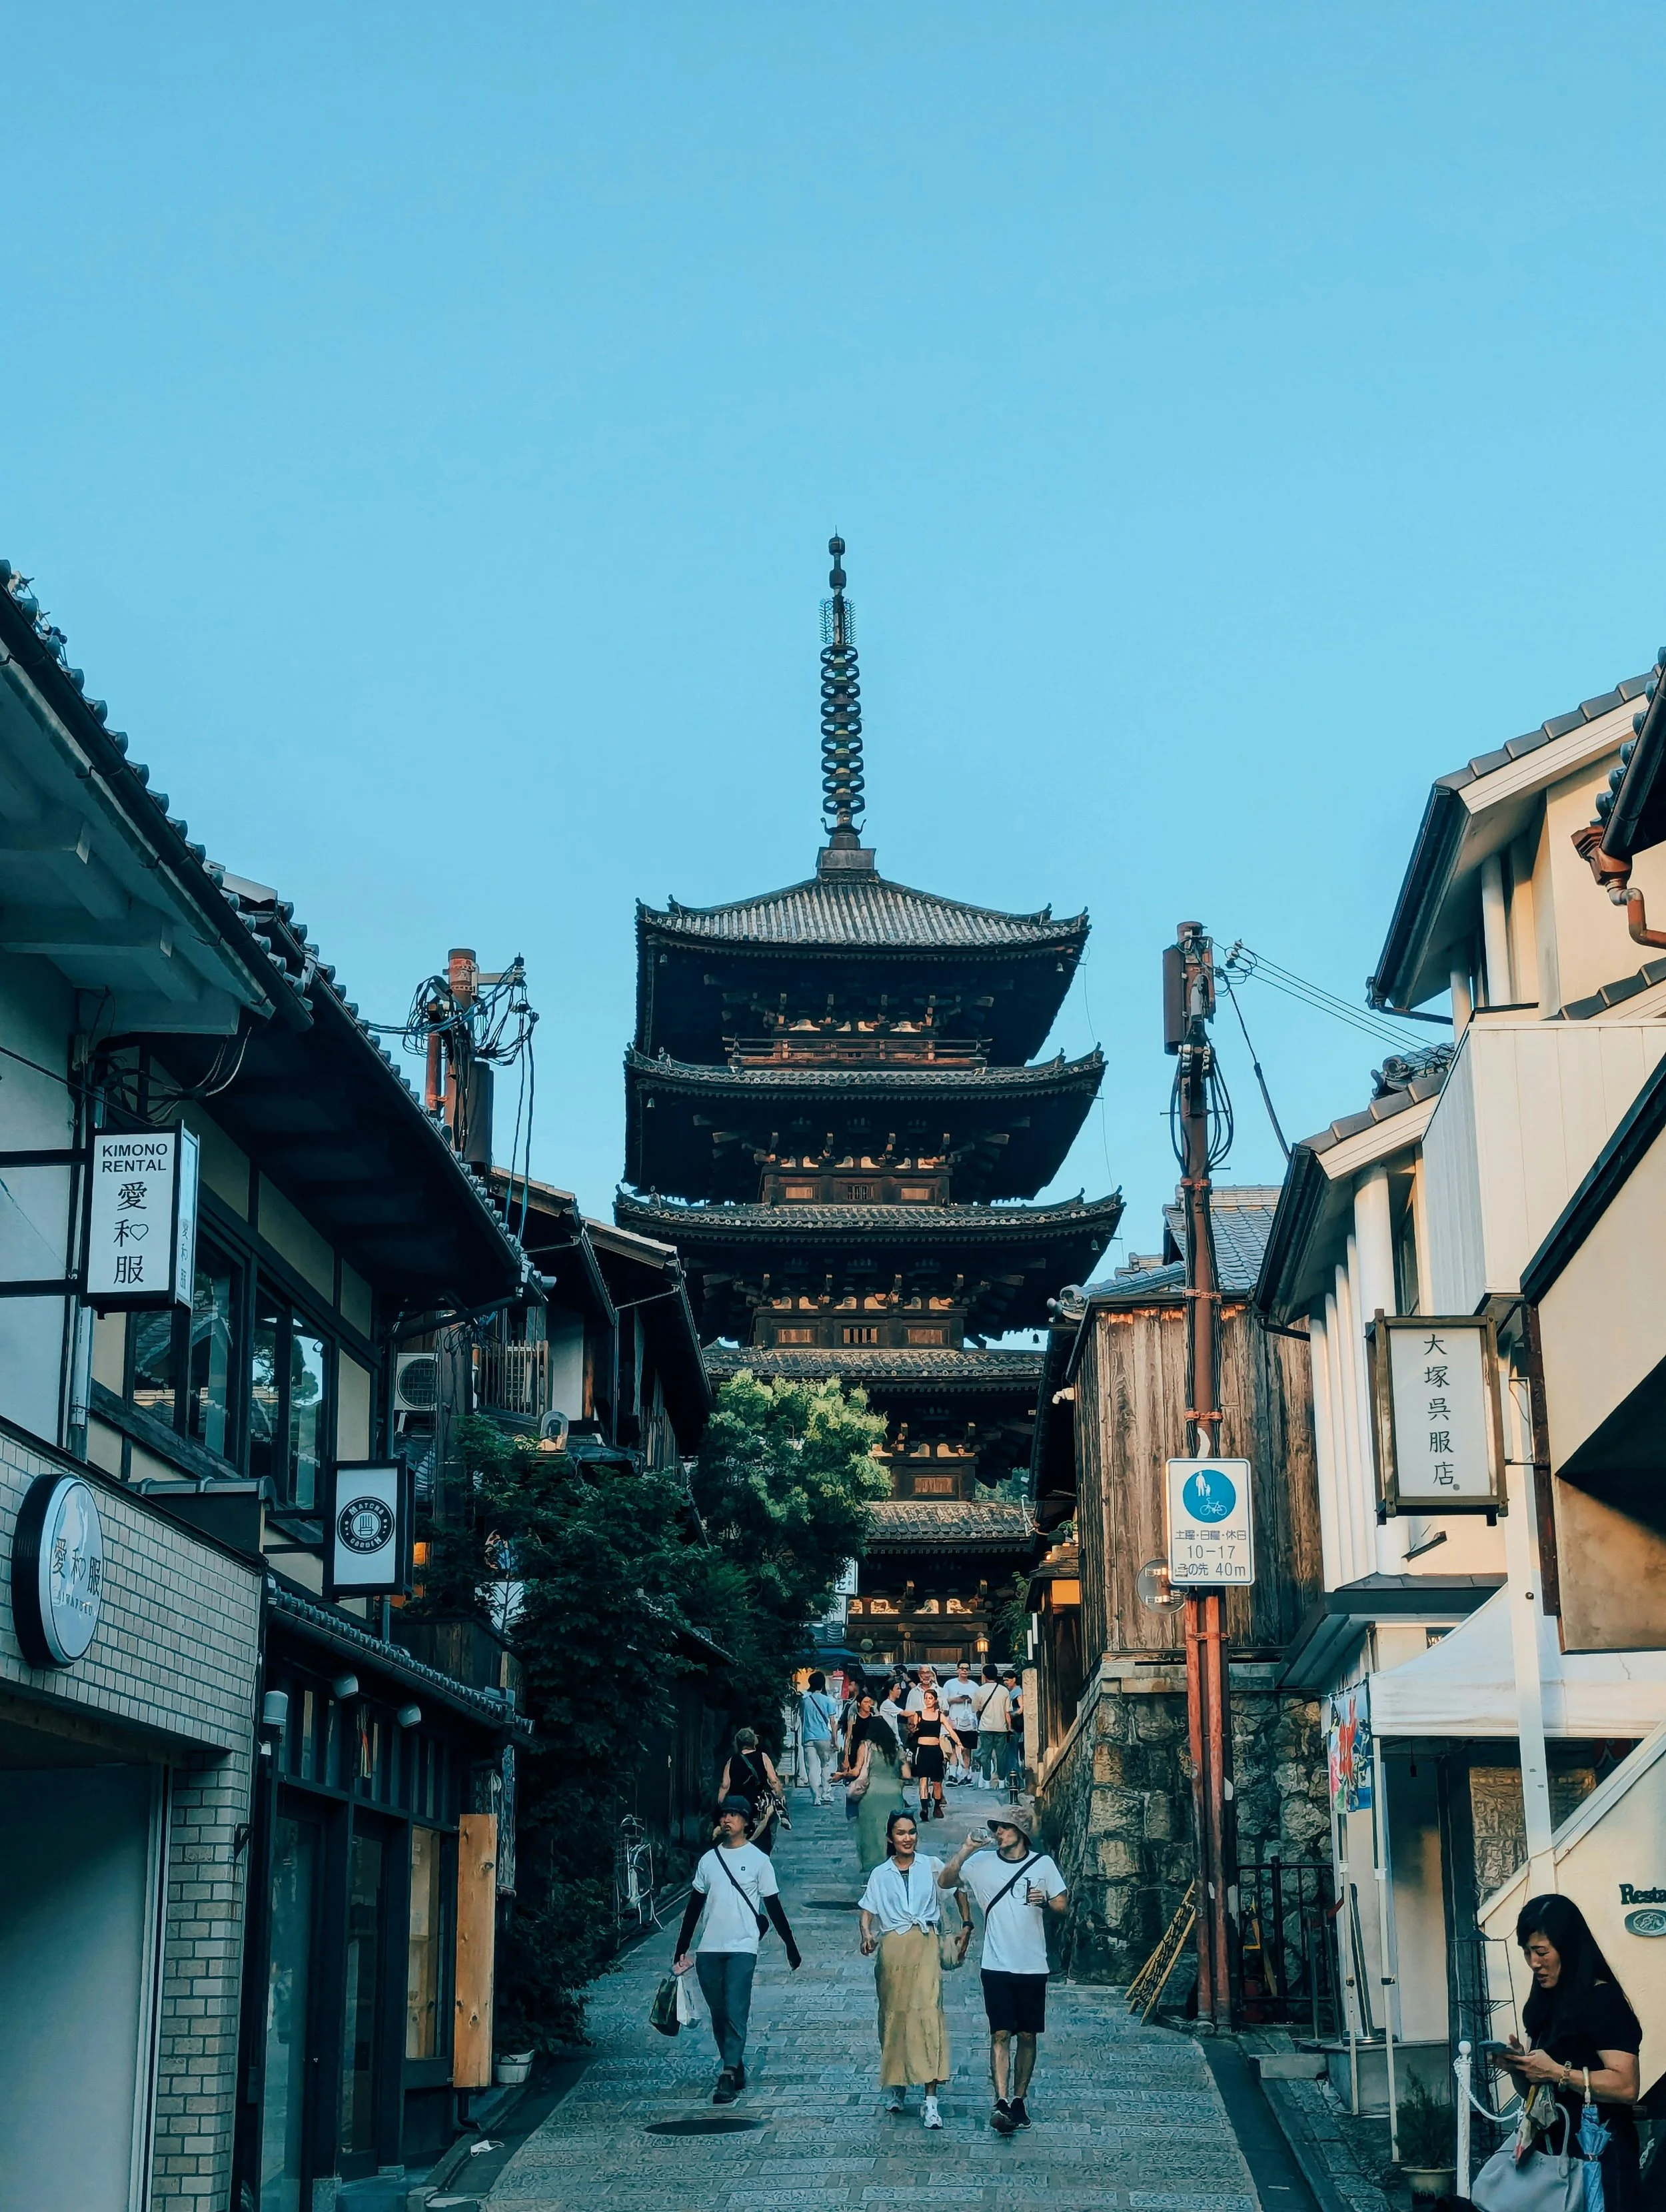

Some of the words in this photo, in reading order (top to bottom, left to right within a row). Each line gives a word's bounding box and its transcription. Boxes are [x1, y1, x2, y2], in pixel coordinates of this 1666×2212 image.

[102, 1143, 168, 1157] KIMONO
[102, 1159, 167, 1173] RENTAL
[113, 1181, 149, 1284] 愛和服
[1423, 1333, 1454, 1486] 大塚呉服店
[349, 1502, 385, 1516] MATCHA
[350, 1536, 383, 1548] GARDEN
[1216, 1562, 1246, 1577] 40m
